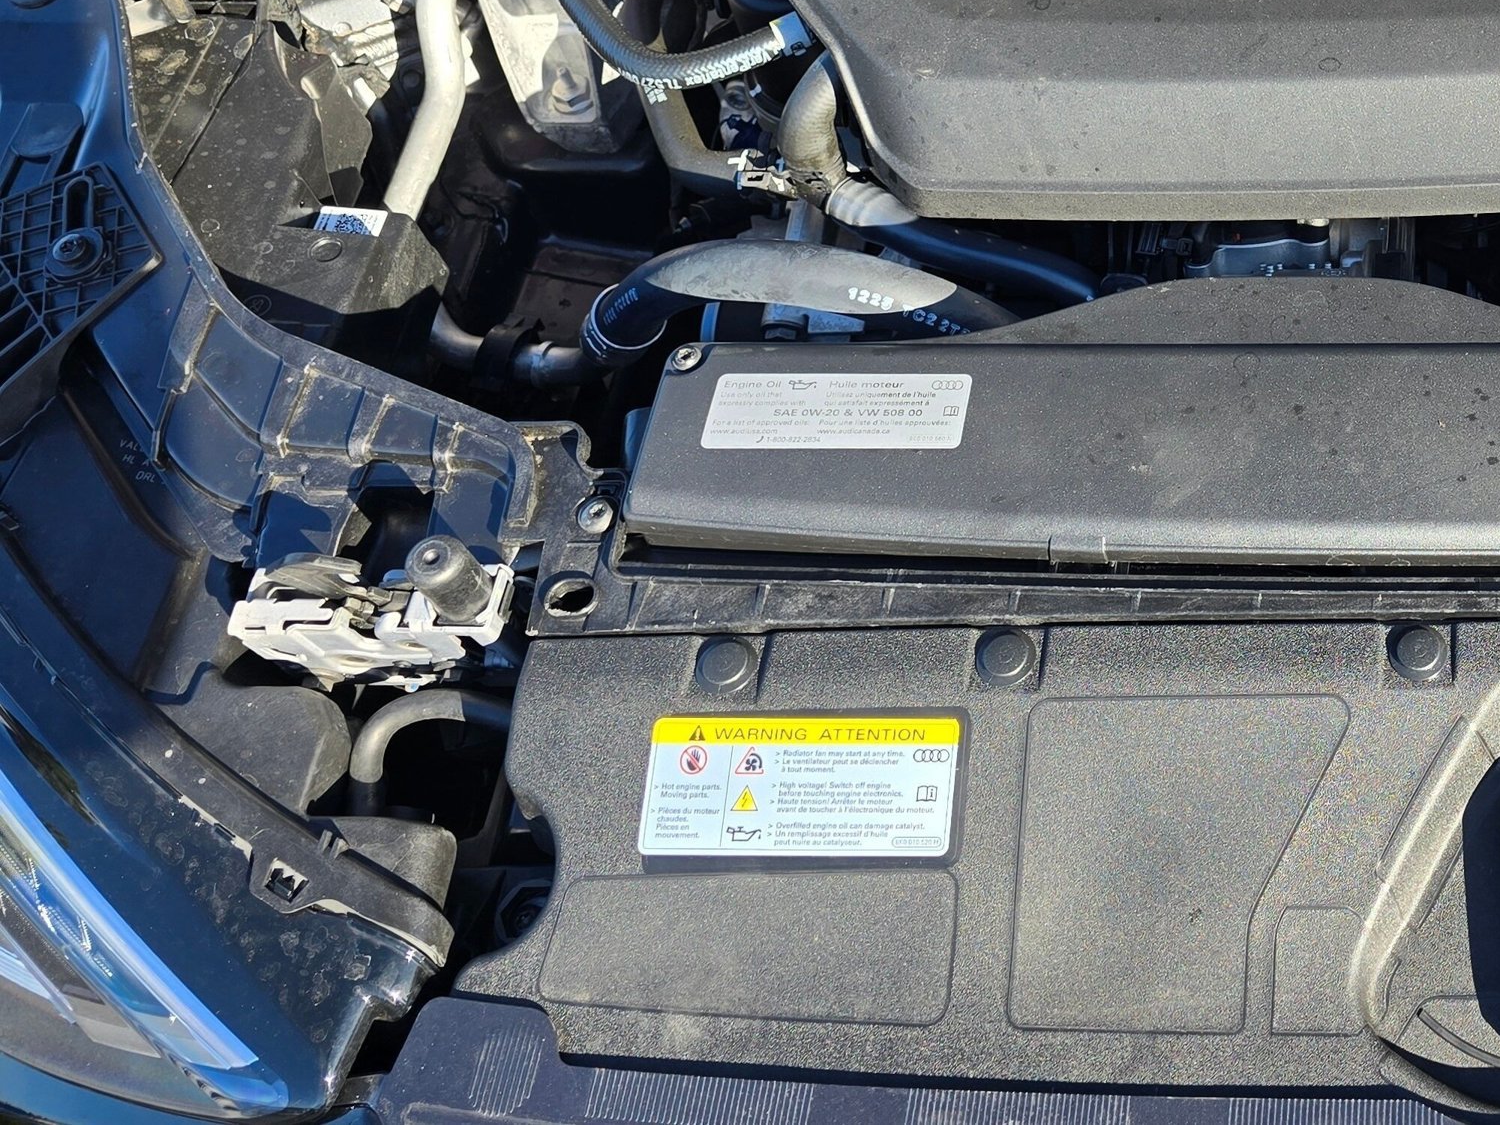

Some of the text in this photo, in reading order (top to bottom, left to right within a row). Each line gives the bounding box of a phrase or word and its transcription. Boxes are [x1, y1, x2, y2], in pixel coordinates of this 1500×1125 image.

[724, 381, 762, 389] Engine
[756, 419, 792, 427] approved
[715, 727, 926, 741] WARNING ATTENTION
[779, 782, 796, 790] High
[798, 782, 827, 790] voltage!
[866, 782, 891, 790] engine
[660, 791, 687, 799] Moving
[803, 790, 835, 798] touching
[656, 823, 679, 831] Pièces
